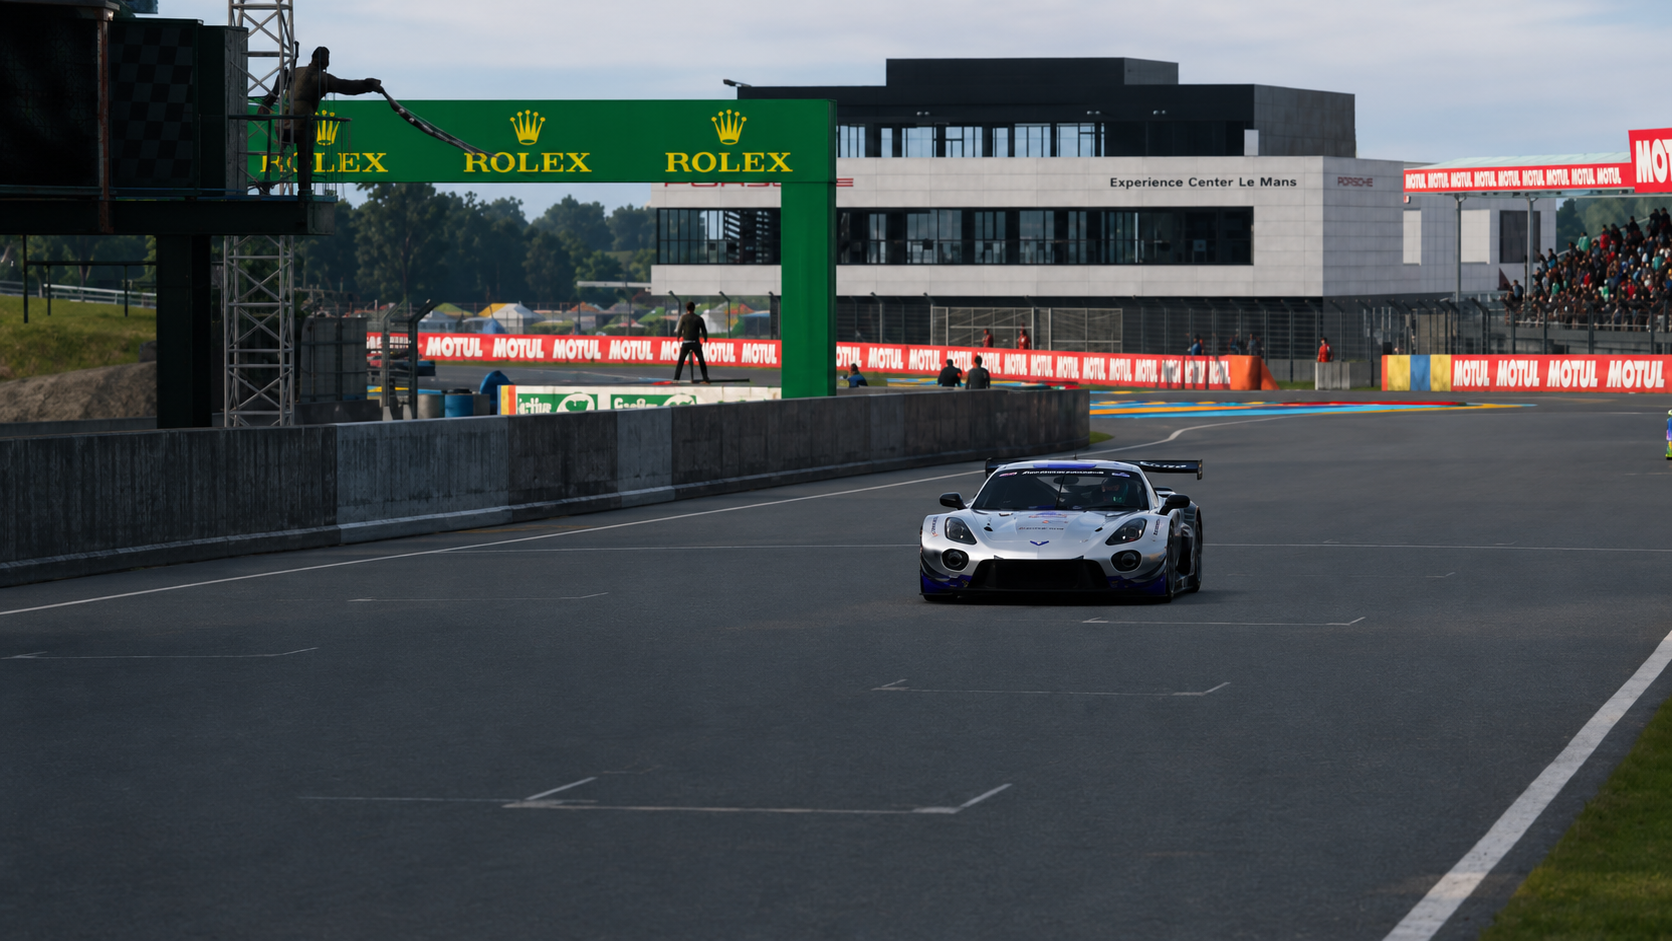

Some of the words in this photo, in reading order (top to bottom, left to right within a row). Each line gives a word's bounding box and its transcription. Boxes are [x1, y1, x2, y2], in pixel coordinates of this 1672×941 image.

[463, 151, 593, 173] ROLEX
[664, 151, 793, 173] ROLEX
[1635, 138, 1672, 184] MOT
[1109, 177, 1184, 190] Experience
[1188, 177, 1234, 188] Center
[1239, 177, 1255, 188] Le
[1259, 177, 1297, 188] Mans
[1337, 176, 1374, 187] PORSCHE
[1405, 173, 1427, 189] MOTUL
[1428, 172, 1449, 188] MOTUL
[1451, 171, 1473, 188] MOTUL
[1474, 171, 1497, 187] MOTUL
[1498, 170, 1521, 187] MOTUL
[1522, 169, 1545, 186] MOTUL
[1546, 168, 1570, 186] MOTUL
[1571, 168, 1595, 185] MOTUL
[1597, 167, 1622, 185] MOTUL
[425, 336, 483, 358] MOTUL
[492, 337, 544, 359] MOTUL
[553, 338, 602, 360] MOTUL
[608, 340, 654, 361] MOTUL
[741, 343, 777, 364] MOTUL
[836, 346, 863, 368] OTUL
[867, 347, 904, 370] MOTUL
[908, 348, 942, 371] MOTUL
[1004, 353, 1027, 377] MOTUL
[1030, 354, 1053, 378] MOTUL
[1056, 355, 1079, 379] MOTUL
[1082, 356, 1106, 381] MOTUL
[1109, 358, 1132, 382] MOTUL
[1134, 359, 1158, 383] MOTUL
[1453, 359, 1490, 387] MOTUL
[1496, 359, 1540, 388] MOTUL
[1546, 359, 1598, 388] MOTUL
[1606, 359, 1665, 388] MOTUL
